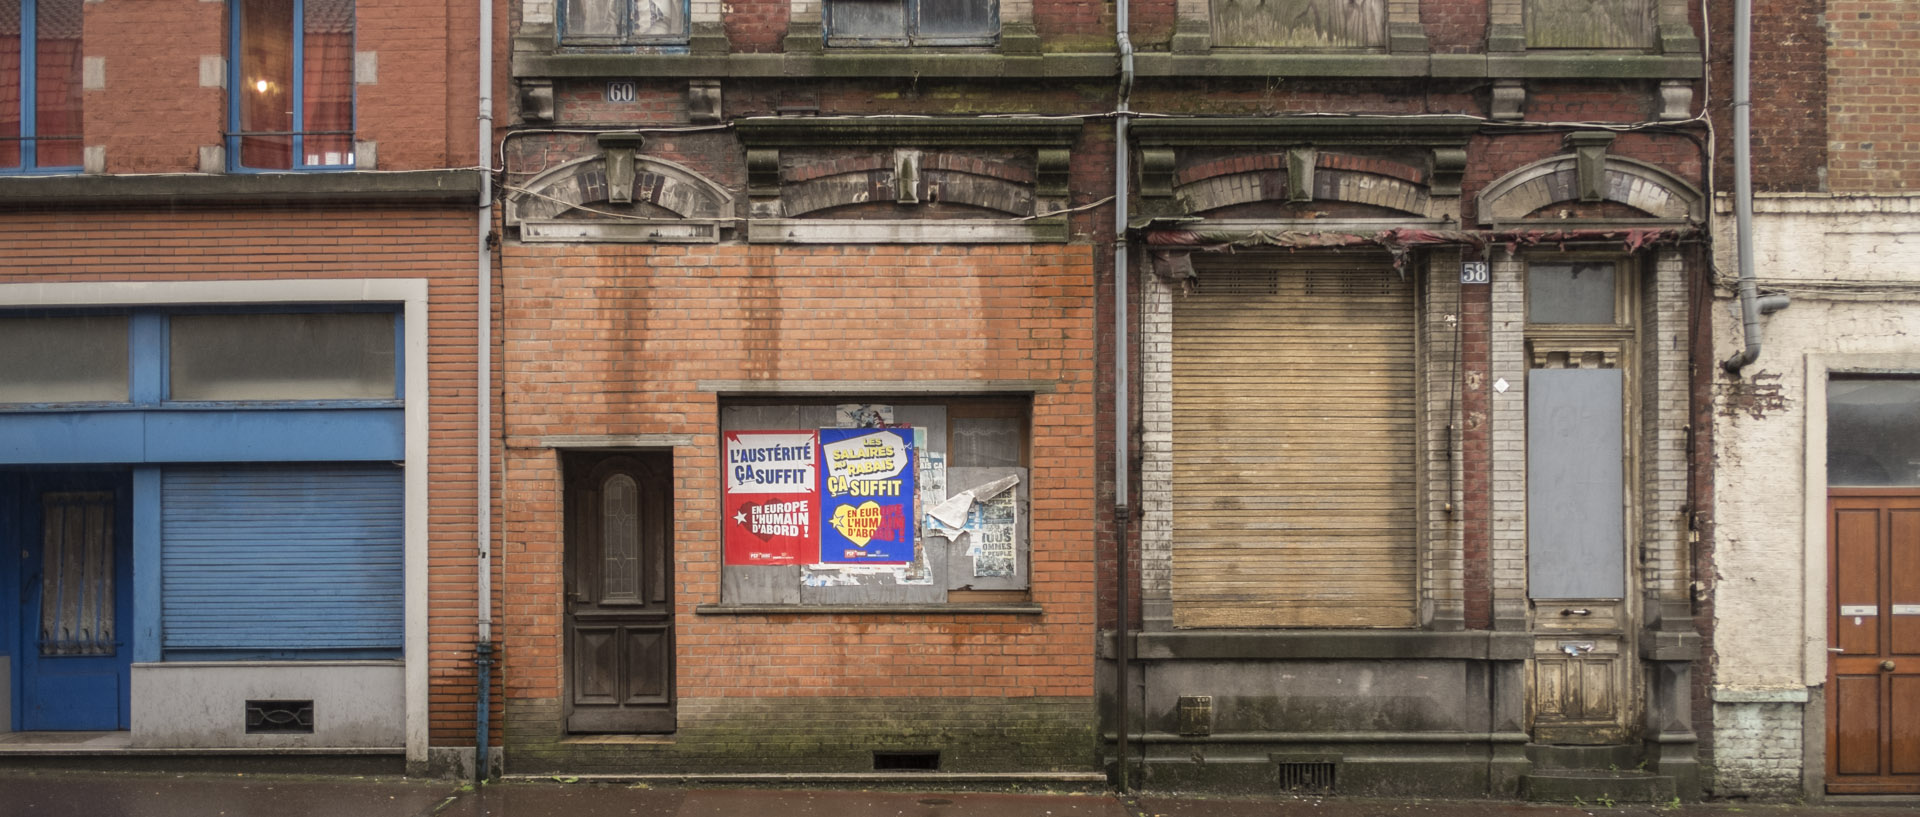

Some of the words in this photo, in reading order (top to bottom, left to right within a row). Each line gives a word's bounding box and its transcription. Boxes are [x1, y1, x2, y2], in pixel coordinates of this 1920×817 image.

[610, 83, 633, 102] 60
[1463, 263, 1486, 282] 58
[863, 438, 883, 447] LES
[730, 442, 812, 464] L'AUSTÉRITÉ
[832, 445, 895, 461] SALAIRES
[735, 464, 755, 486] ÇA
[755, 468, 807, 485] SUFFIT
[833, 460, 848, 471] AU
[847, 458, 895, 477] RABAIS
[827, 475, 849, 497] ÇA
[849, 479, 902, 496] SUFFIT
[752, 505, 762, 515] EN
[764, 500, 809, 514] EUROPE
[847, 509, 857, 518] EN
[860, 503, 904, 518] EUROPE
[752, 512, 809, 525] L'HUMAIN
[847, 515, 906, 530] L'HUMAIN
[752, 524, 799, 537] D'ABORD
[803, 525, 809, 538] !
[847, 528, 895, 542] D'ABORD
